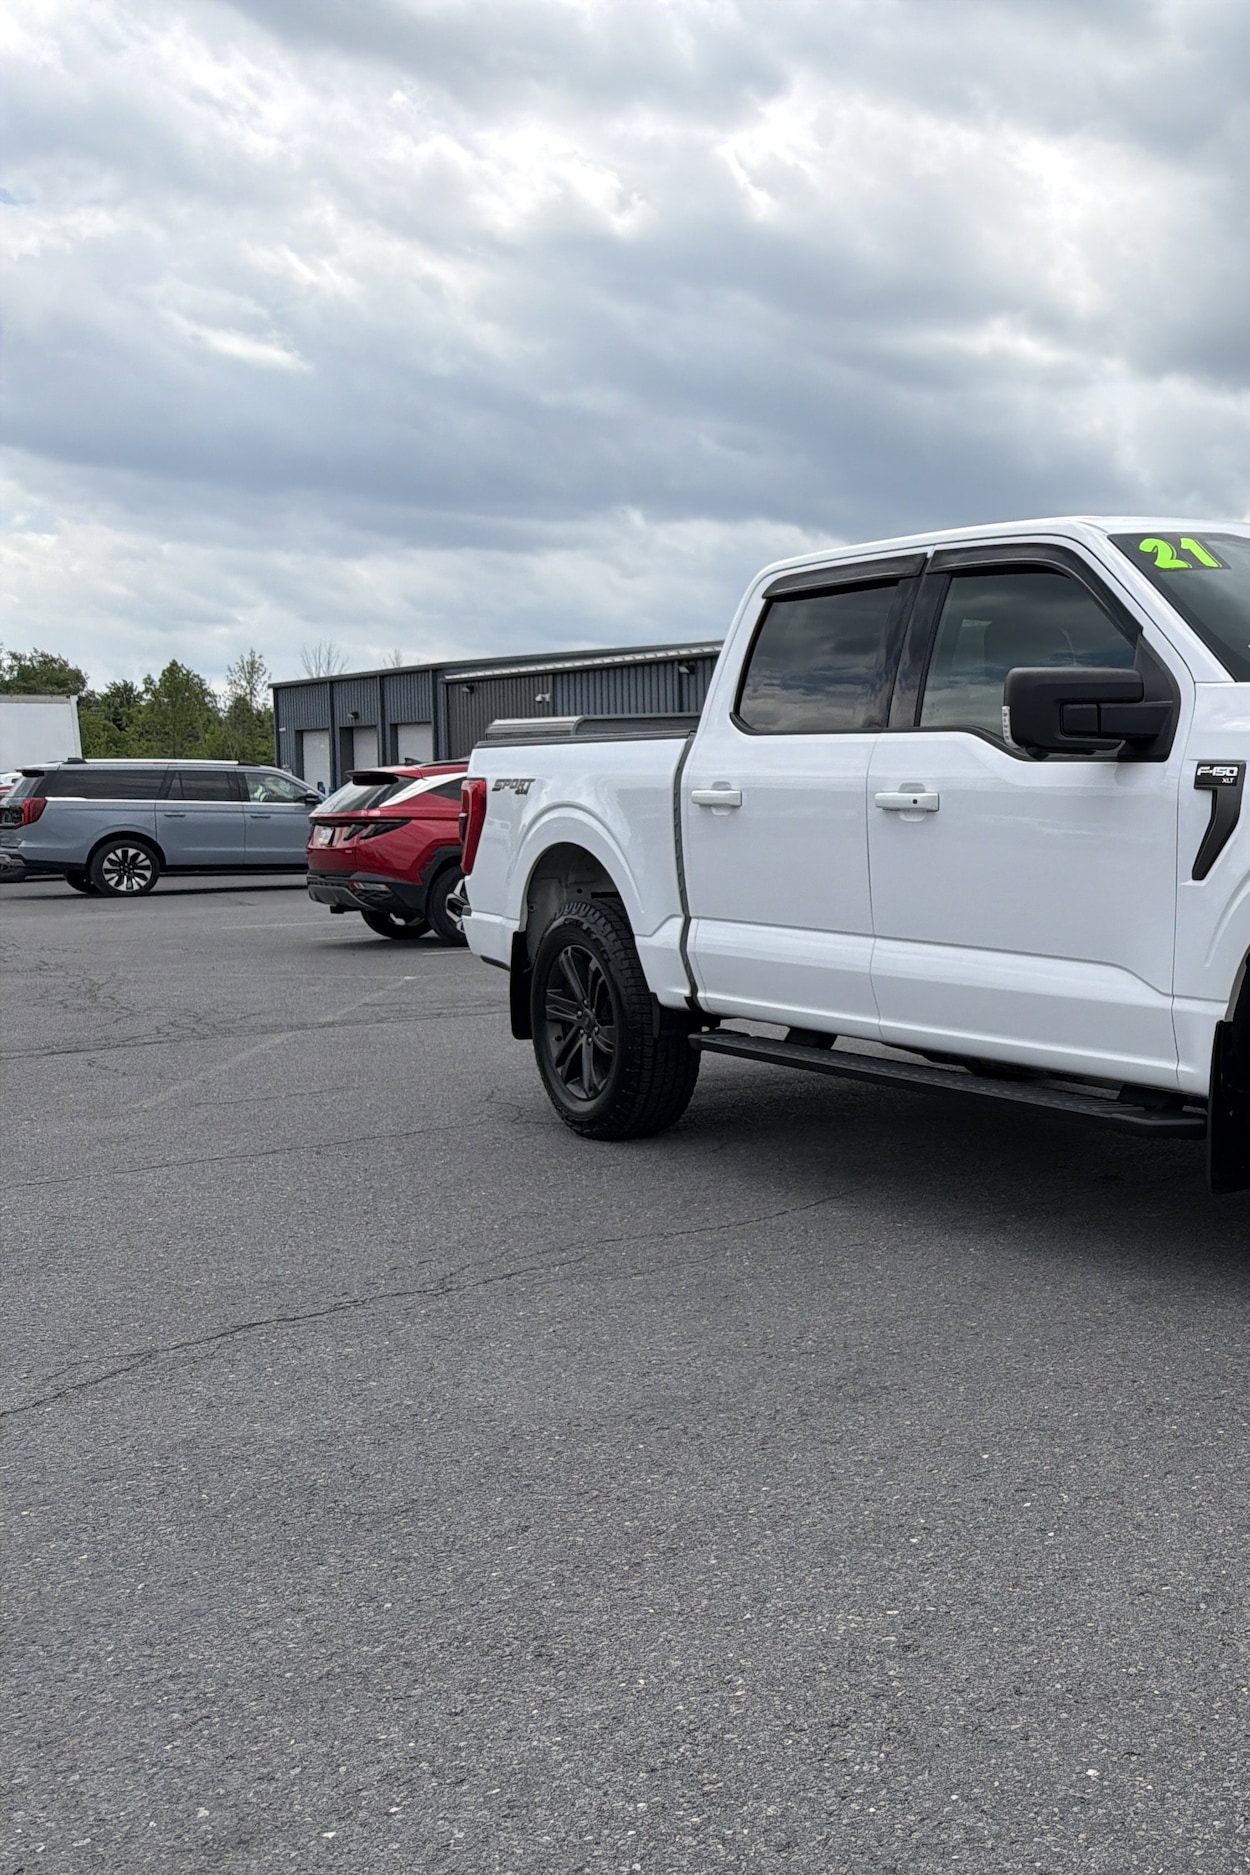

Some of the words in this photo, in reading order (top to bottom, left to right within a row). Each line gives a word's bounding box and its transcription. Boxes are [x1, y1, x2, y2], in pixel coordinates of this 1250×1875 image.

[1139, 537, 1223, 569] 21
[1196, 766, 1239, 777] F-150
[491, 778, 536, 793] SPORT
